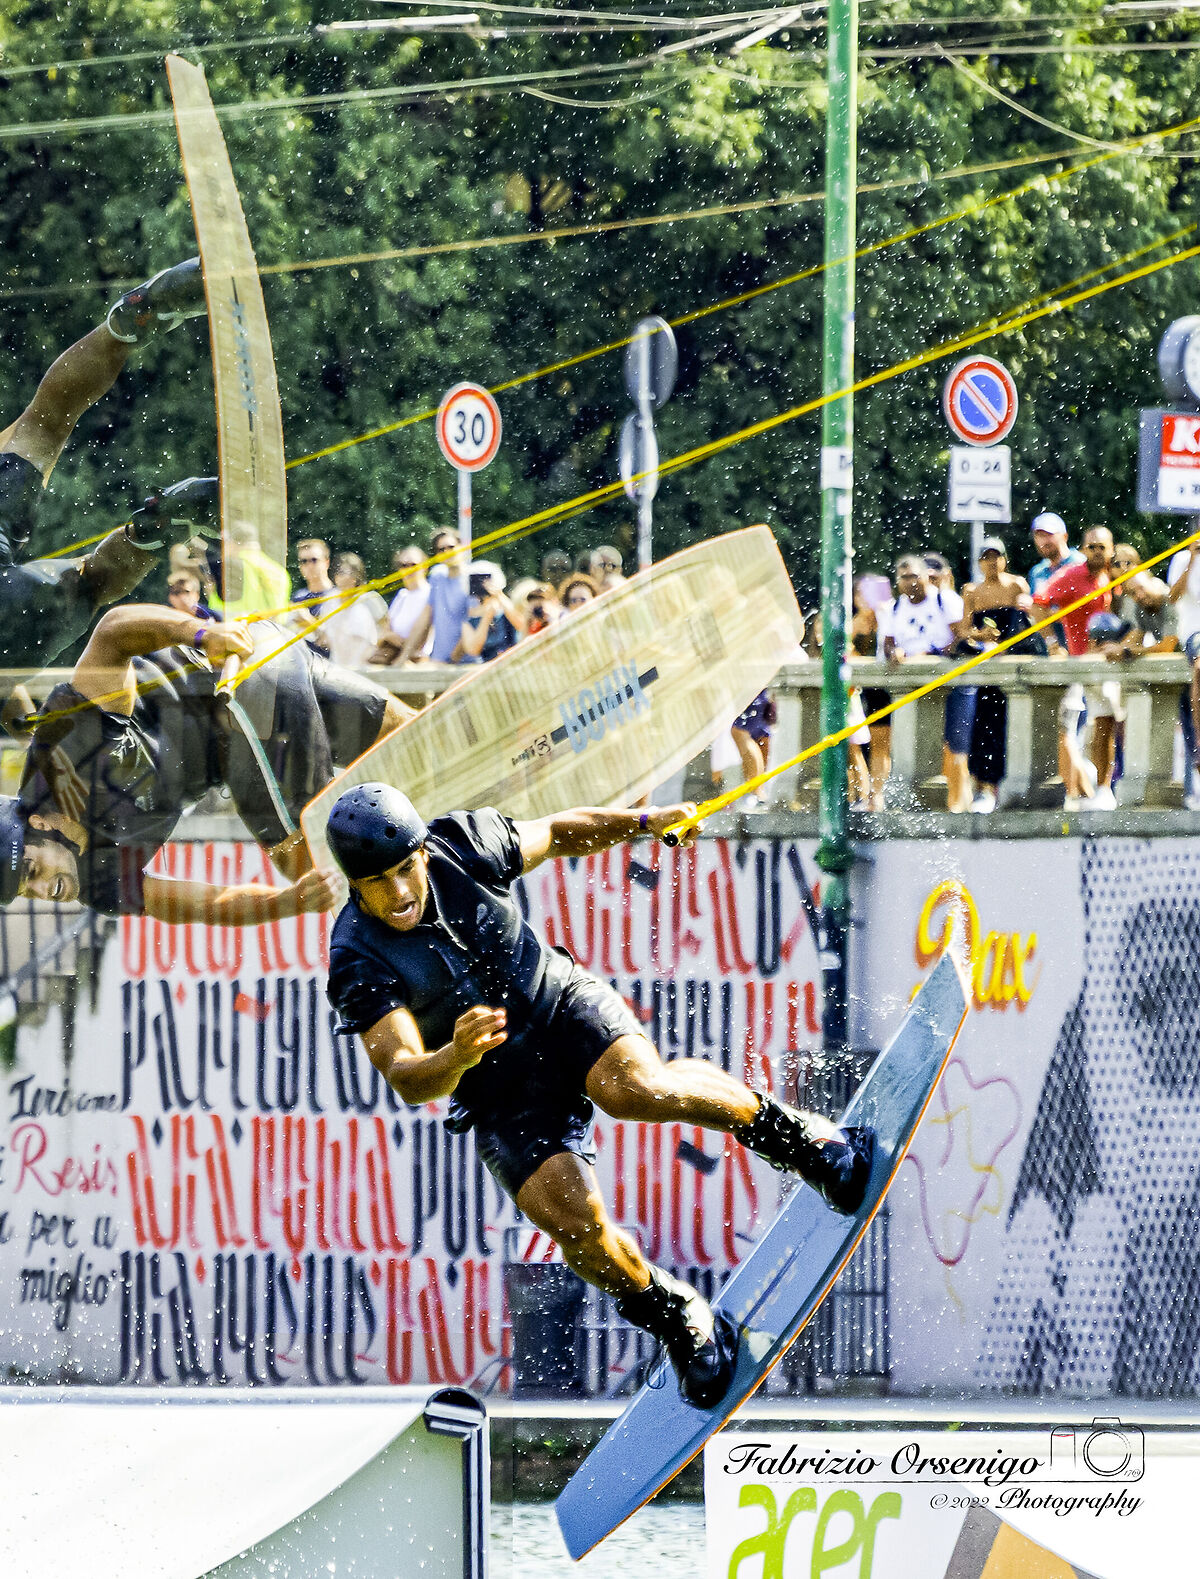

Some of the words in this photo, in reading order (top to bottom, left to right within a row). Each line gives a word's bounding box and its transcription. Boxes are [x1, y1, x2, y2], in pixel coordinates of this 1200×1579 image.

[455, 410, 485, 446] 30
[25, 1210, 78, 1257] per
[728, 1484, 903, 1579] acer
